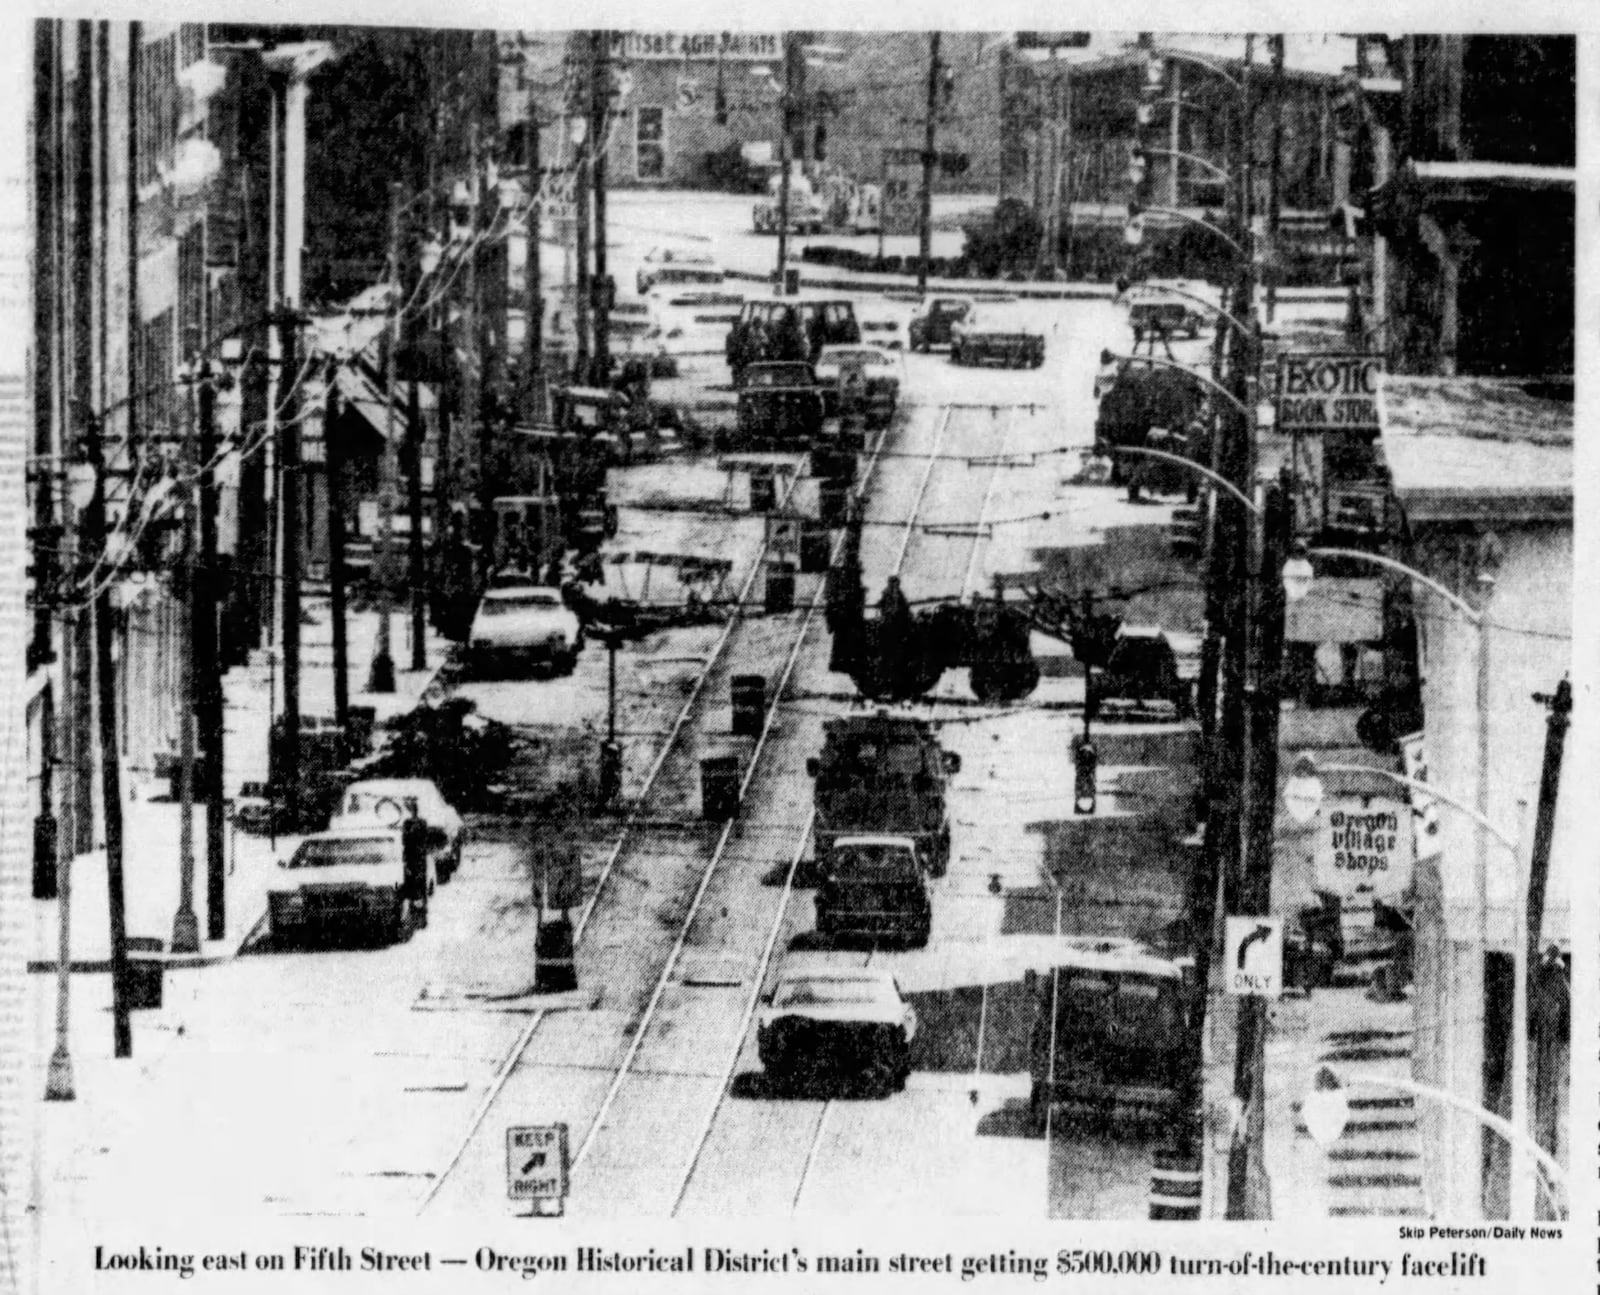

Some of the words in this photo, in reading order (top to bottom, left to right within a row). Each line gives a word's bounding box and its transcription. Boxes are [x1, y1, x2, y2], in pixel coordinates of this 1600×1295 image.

[1287, 361, 1380, 394] EXOTIC
[1281, 399, 1323, 423] BOOK
[1330, 811, 1397, 833] Oregon
[1334, 851, 1388, 877] Shops
[1233, 973, 1273, 989] ONLY
[514, 1131, 555, 1148] KEEP
[514, 1178, 557, 1194] RIGHT
